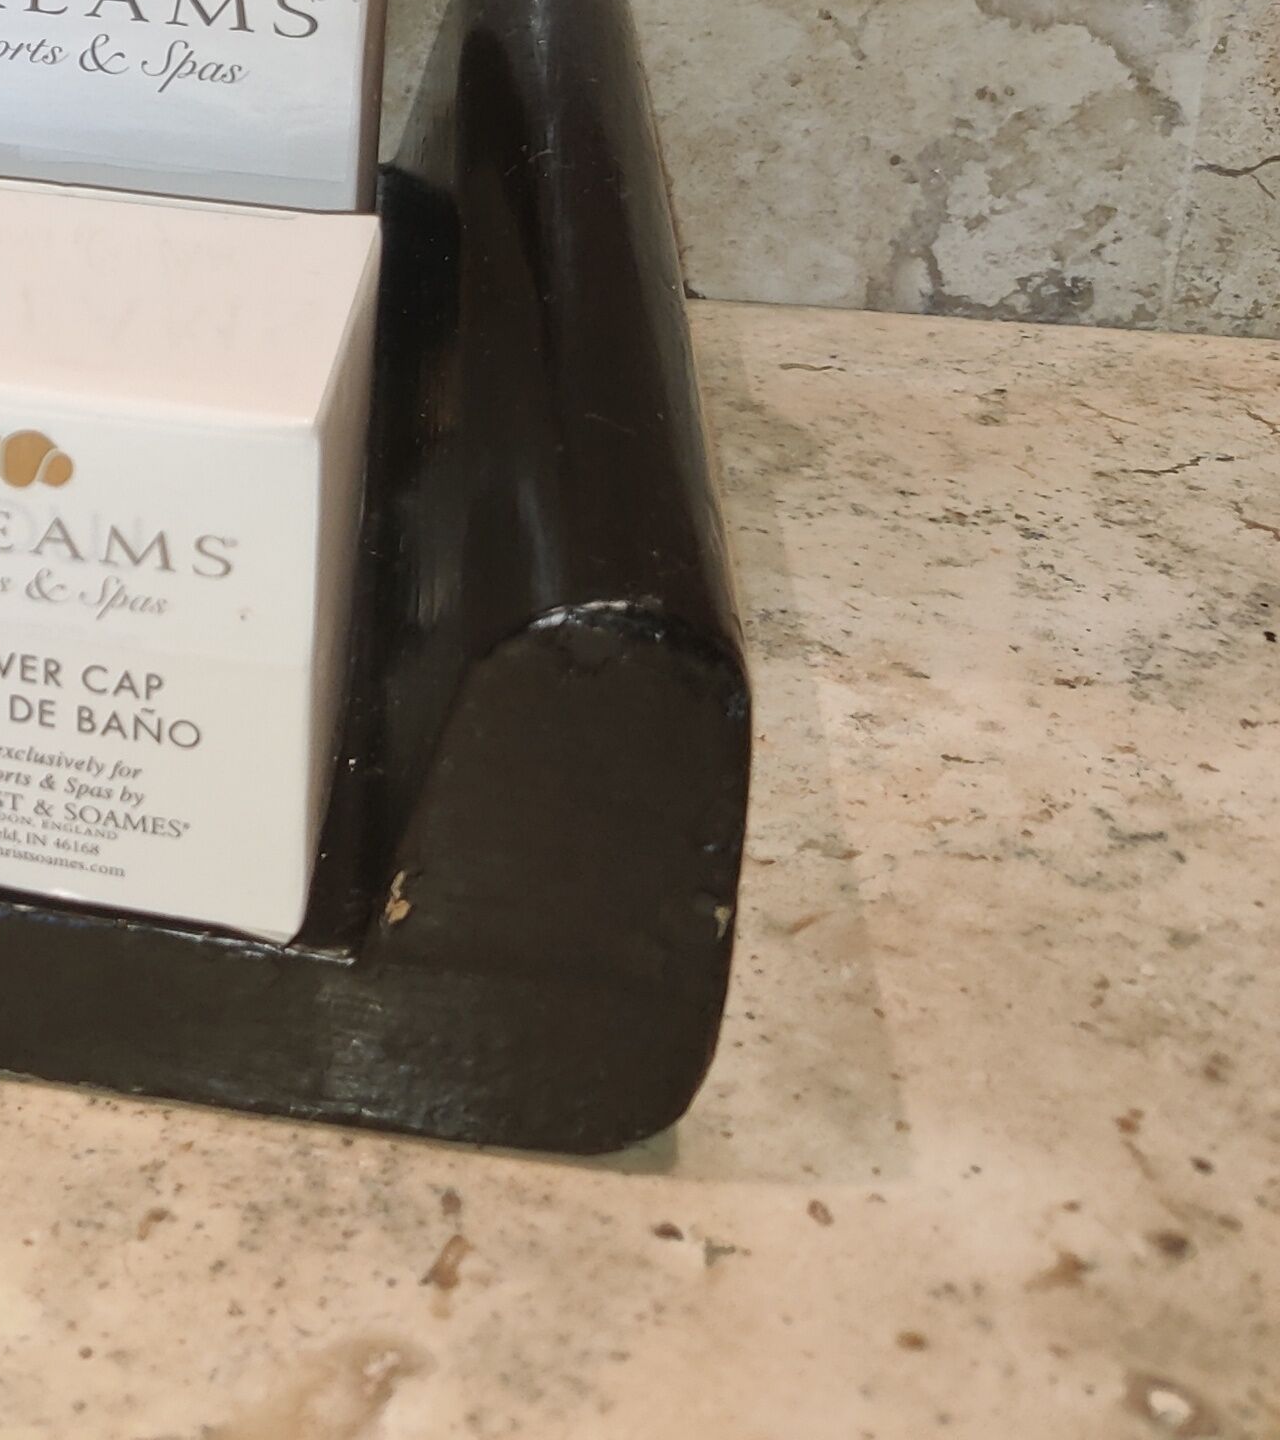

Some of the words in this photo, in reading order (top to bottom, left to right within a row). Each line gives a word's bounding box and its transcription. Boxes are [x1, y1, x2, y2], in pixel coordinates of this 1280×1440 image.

[78, 33, 130, 76] &
[140, 38, 250, 94] Spas
[25, 567, 66, 602] &
[78, 574, 169, 621] Spas
[81, 664, 165, 702] CAP
[9, 693, 57, 729] DE
[76, 706, 202, 750] BAÑO
[63, 776, 114, 805] Spas
[119, 785, 146, 808] by
[108, 759, 144, 782] for
